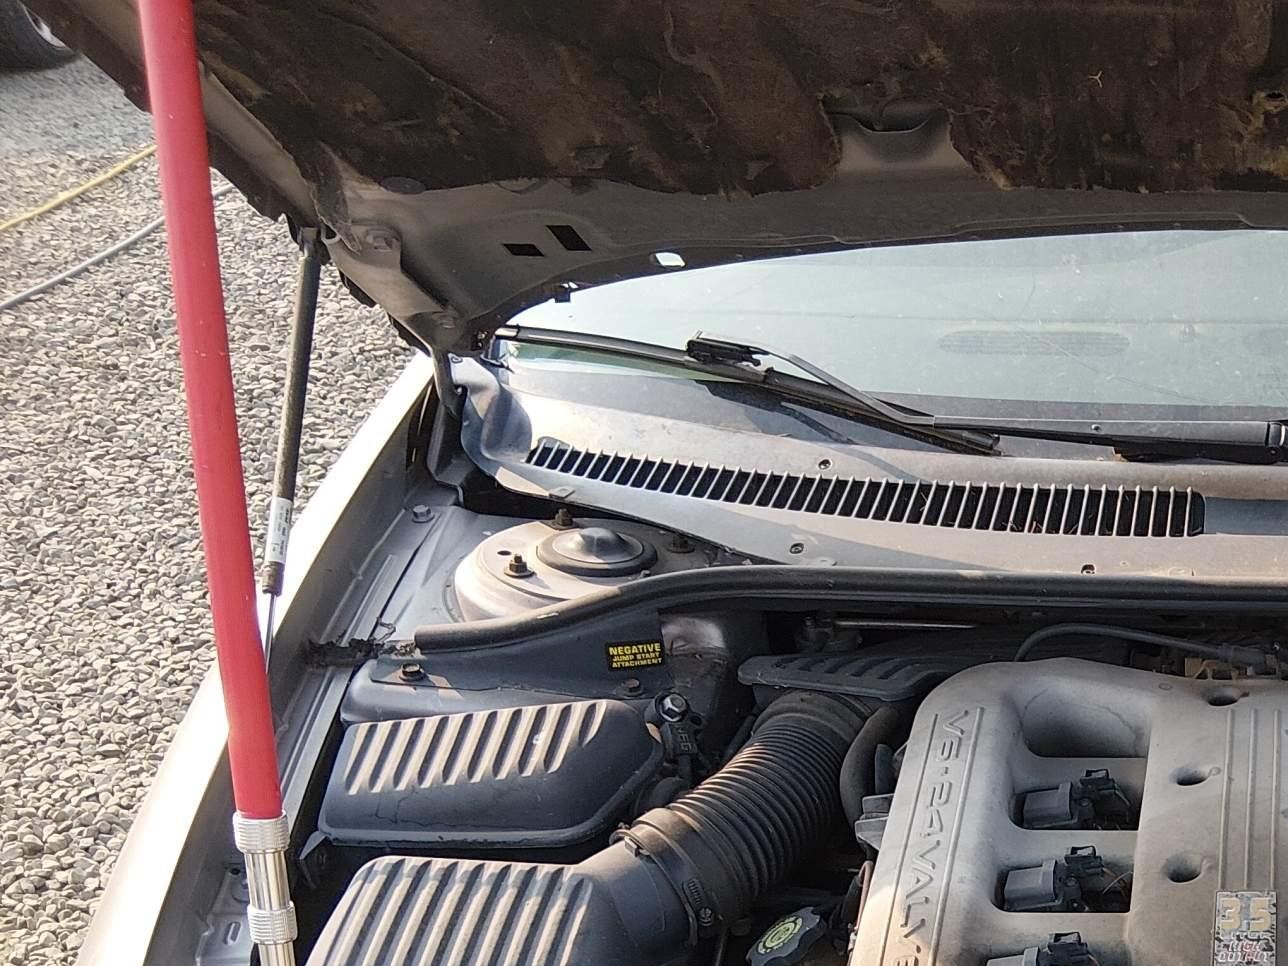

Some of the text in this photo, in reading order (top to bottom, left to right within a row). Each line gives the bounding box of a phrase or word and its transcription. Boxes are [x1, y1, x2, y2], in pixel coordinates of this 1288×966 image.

[608, 643, 661, 655] NEGATIVE
[636, 652, 660, 660] START
[612, 658, 662, 668] ATTACHMENT
